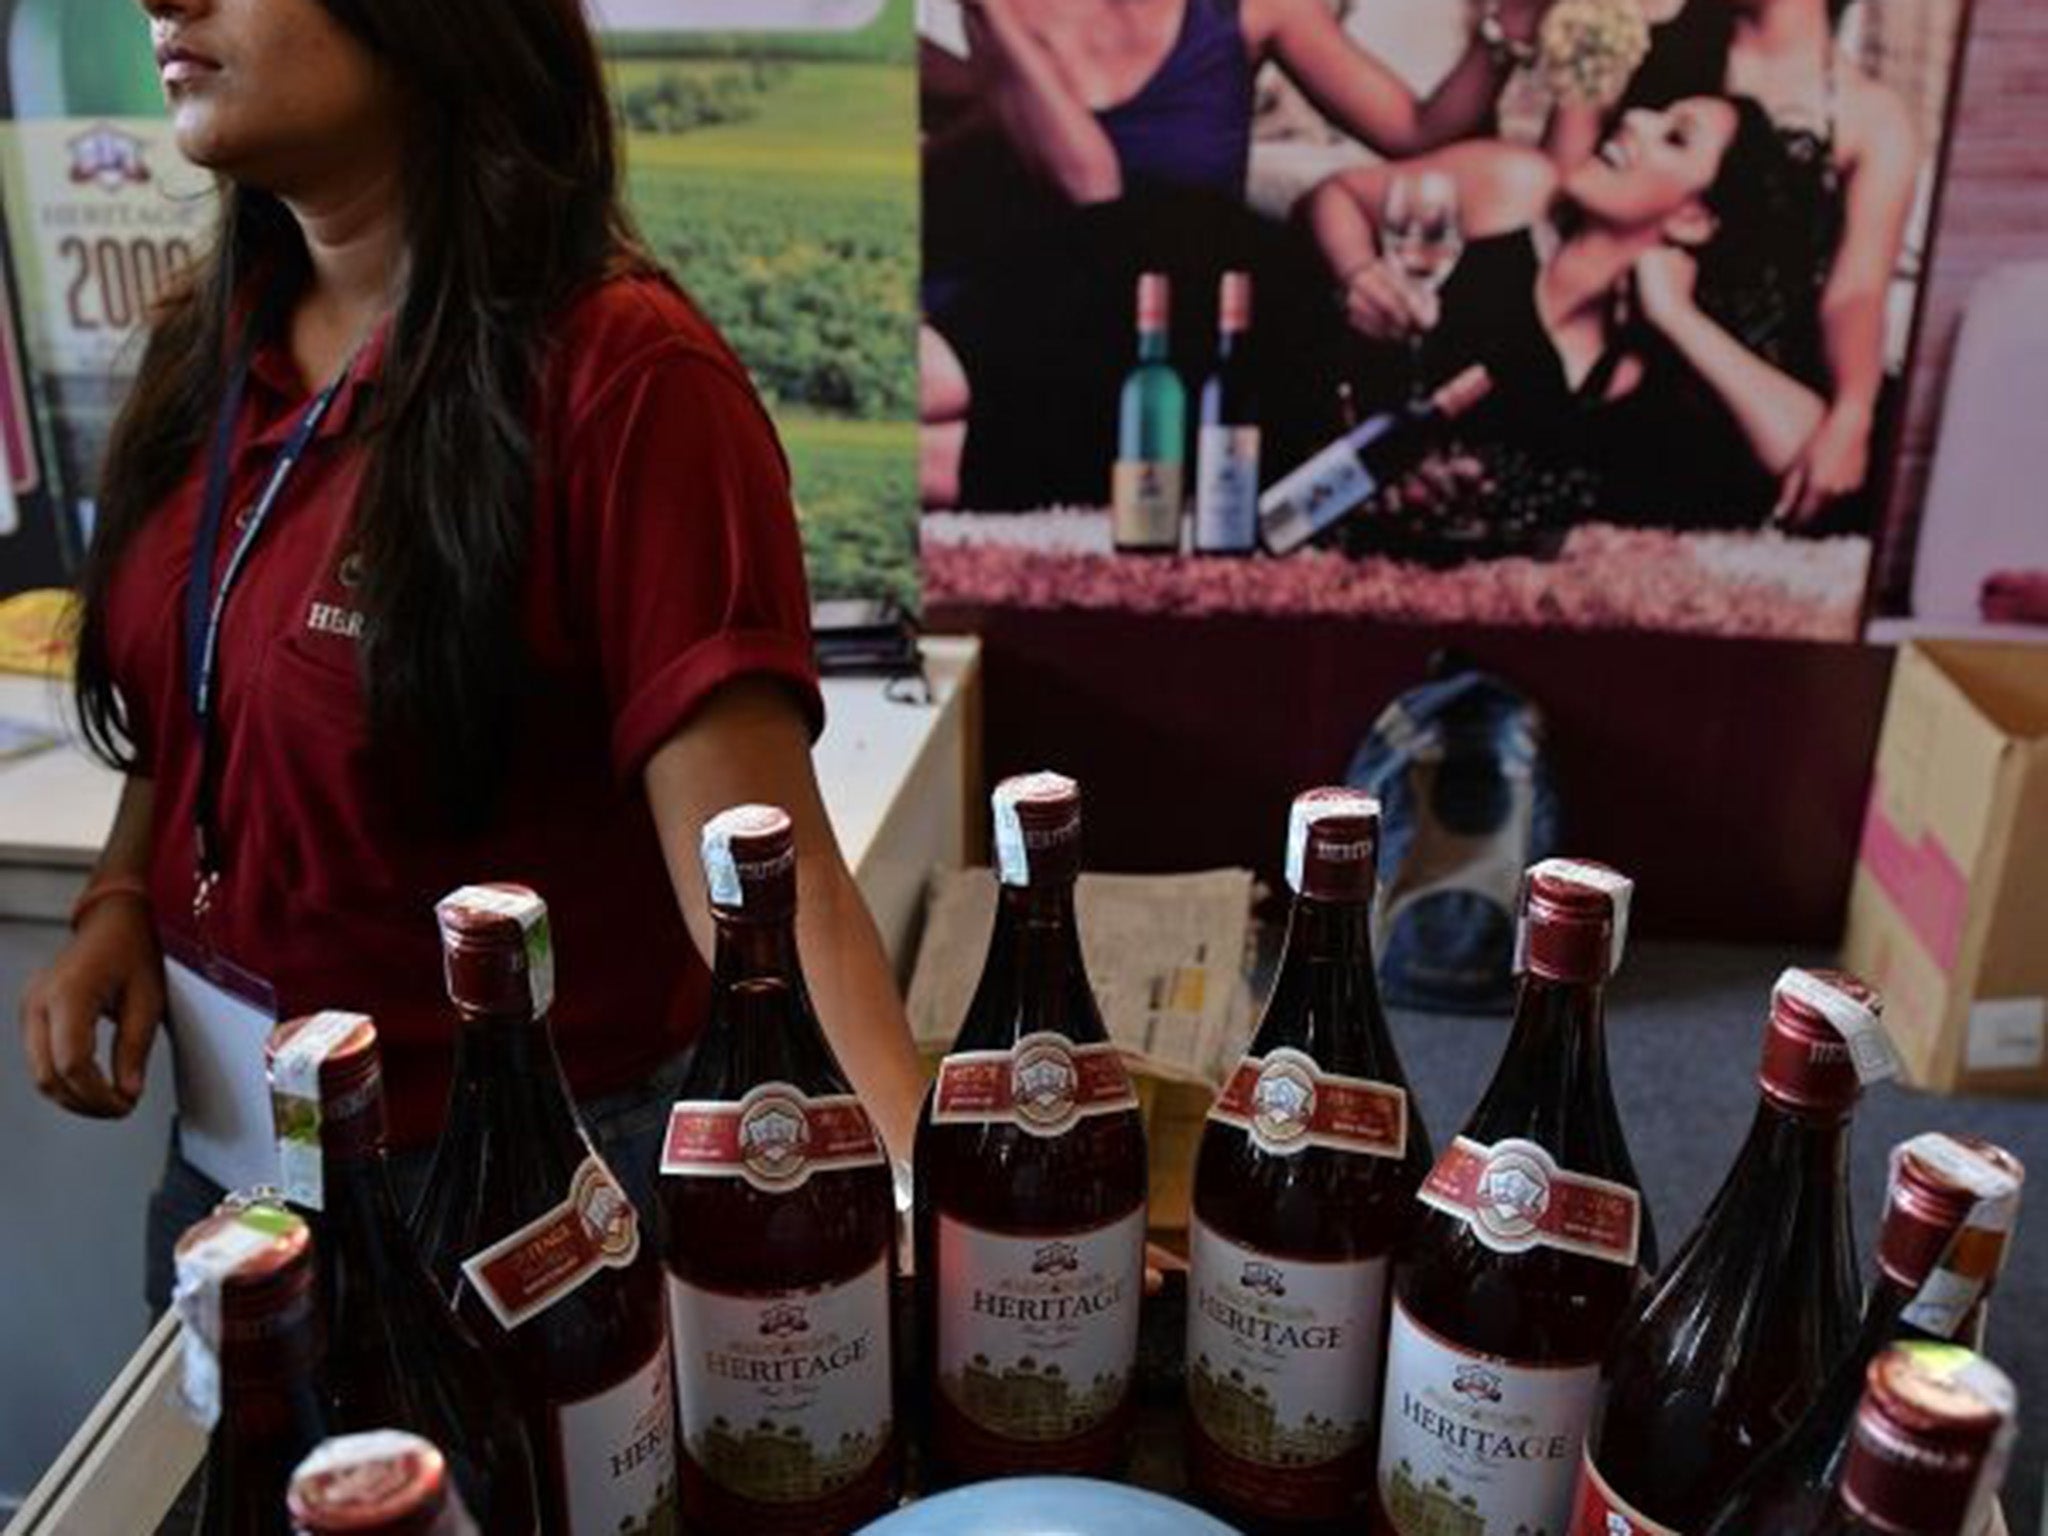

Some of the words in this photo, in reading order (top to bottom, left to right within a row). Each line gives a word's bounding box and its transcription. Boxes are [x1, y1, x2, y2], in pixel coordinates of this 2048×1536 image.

[1198, 1287, 1344, 1350] HERITAGE
[704, 1336, 868, 1383] HERITAGE
[1401, 1390, 1568, 1461] HERITAGE
